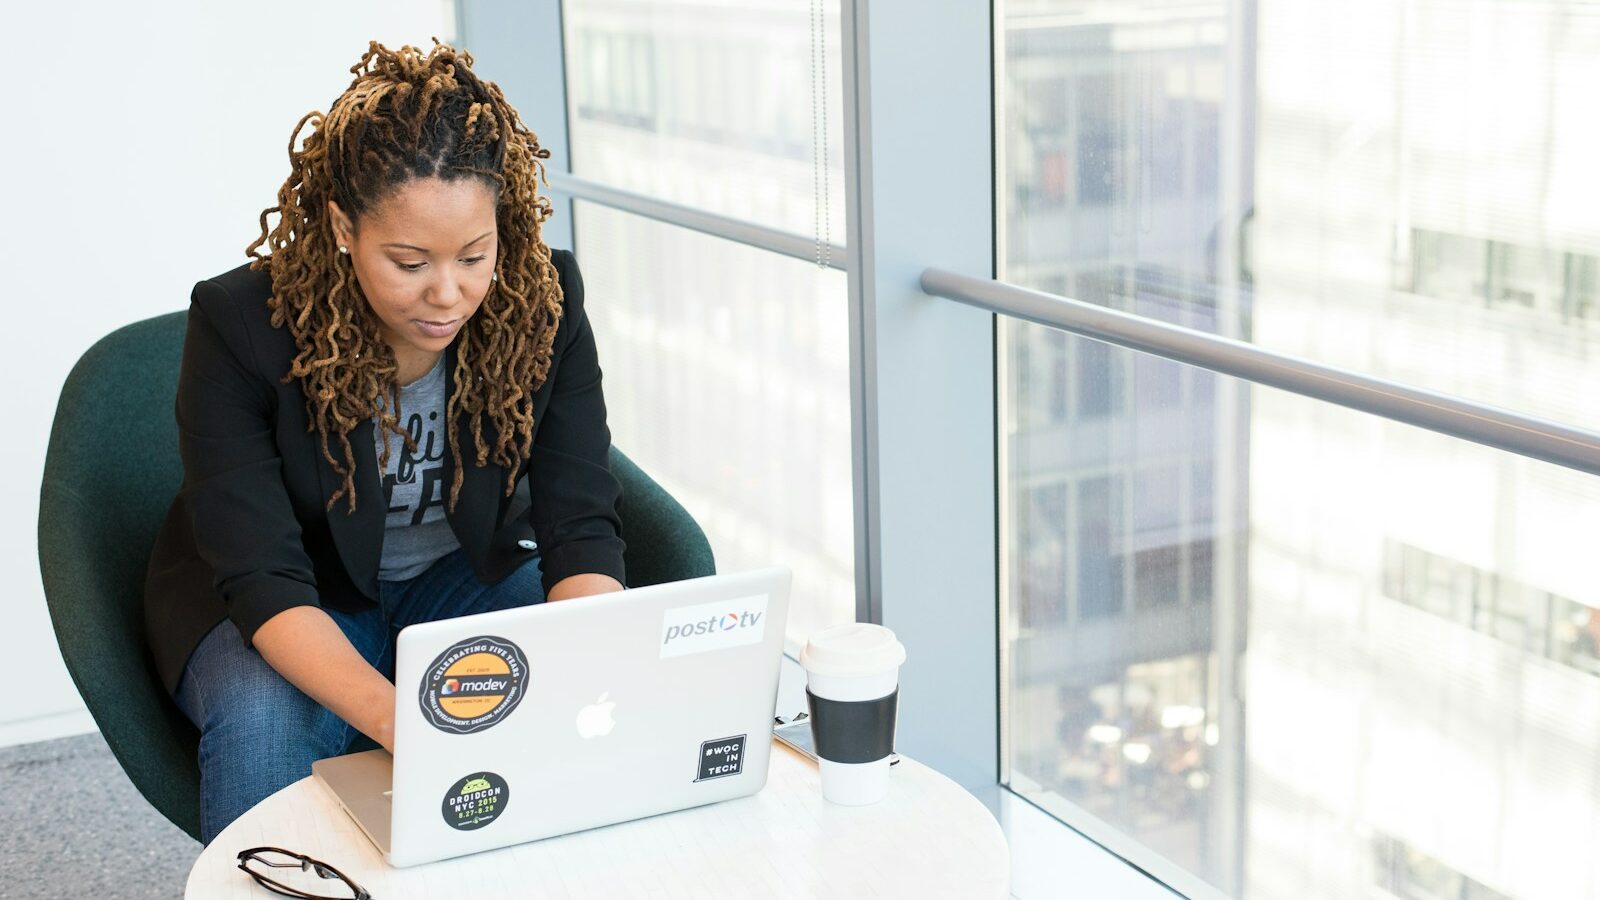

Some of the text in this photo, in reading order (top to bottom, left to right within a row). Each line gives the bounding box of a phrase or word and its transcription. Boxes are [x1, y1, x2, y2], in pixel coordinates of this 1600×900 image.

[664, 610, 762, 645] post tv
[434, 645, 520, 680] CELEBRATING FIVE YEARS
[461, 679, 507, 691] modev
[706, 744, 740, 756] #WOC
[708, 763, 737, 775] TECH
[450, 787, 501, 805] DROIDCON
[455, 796, 497, 812] NYC 2015
[458, 806, 494, 818] 8.27-8.28
